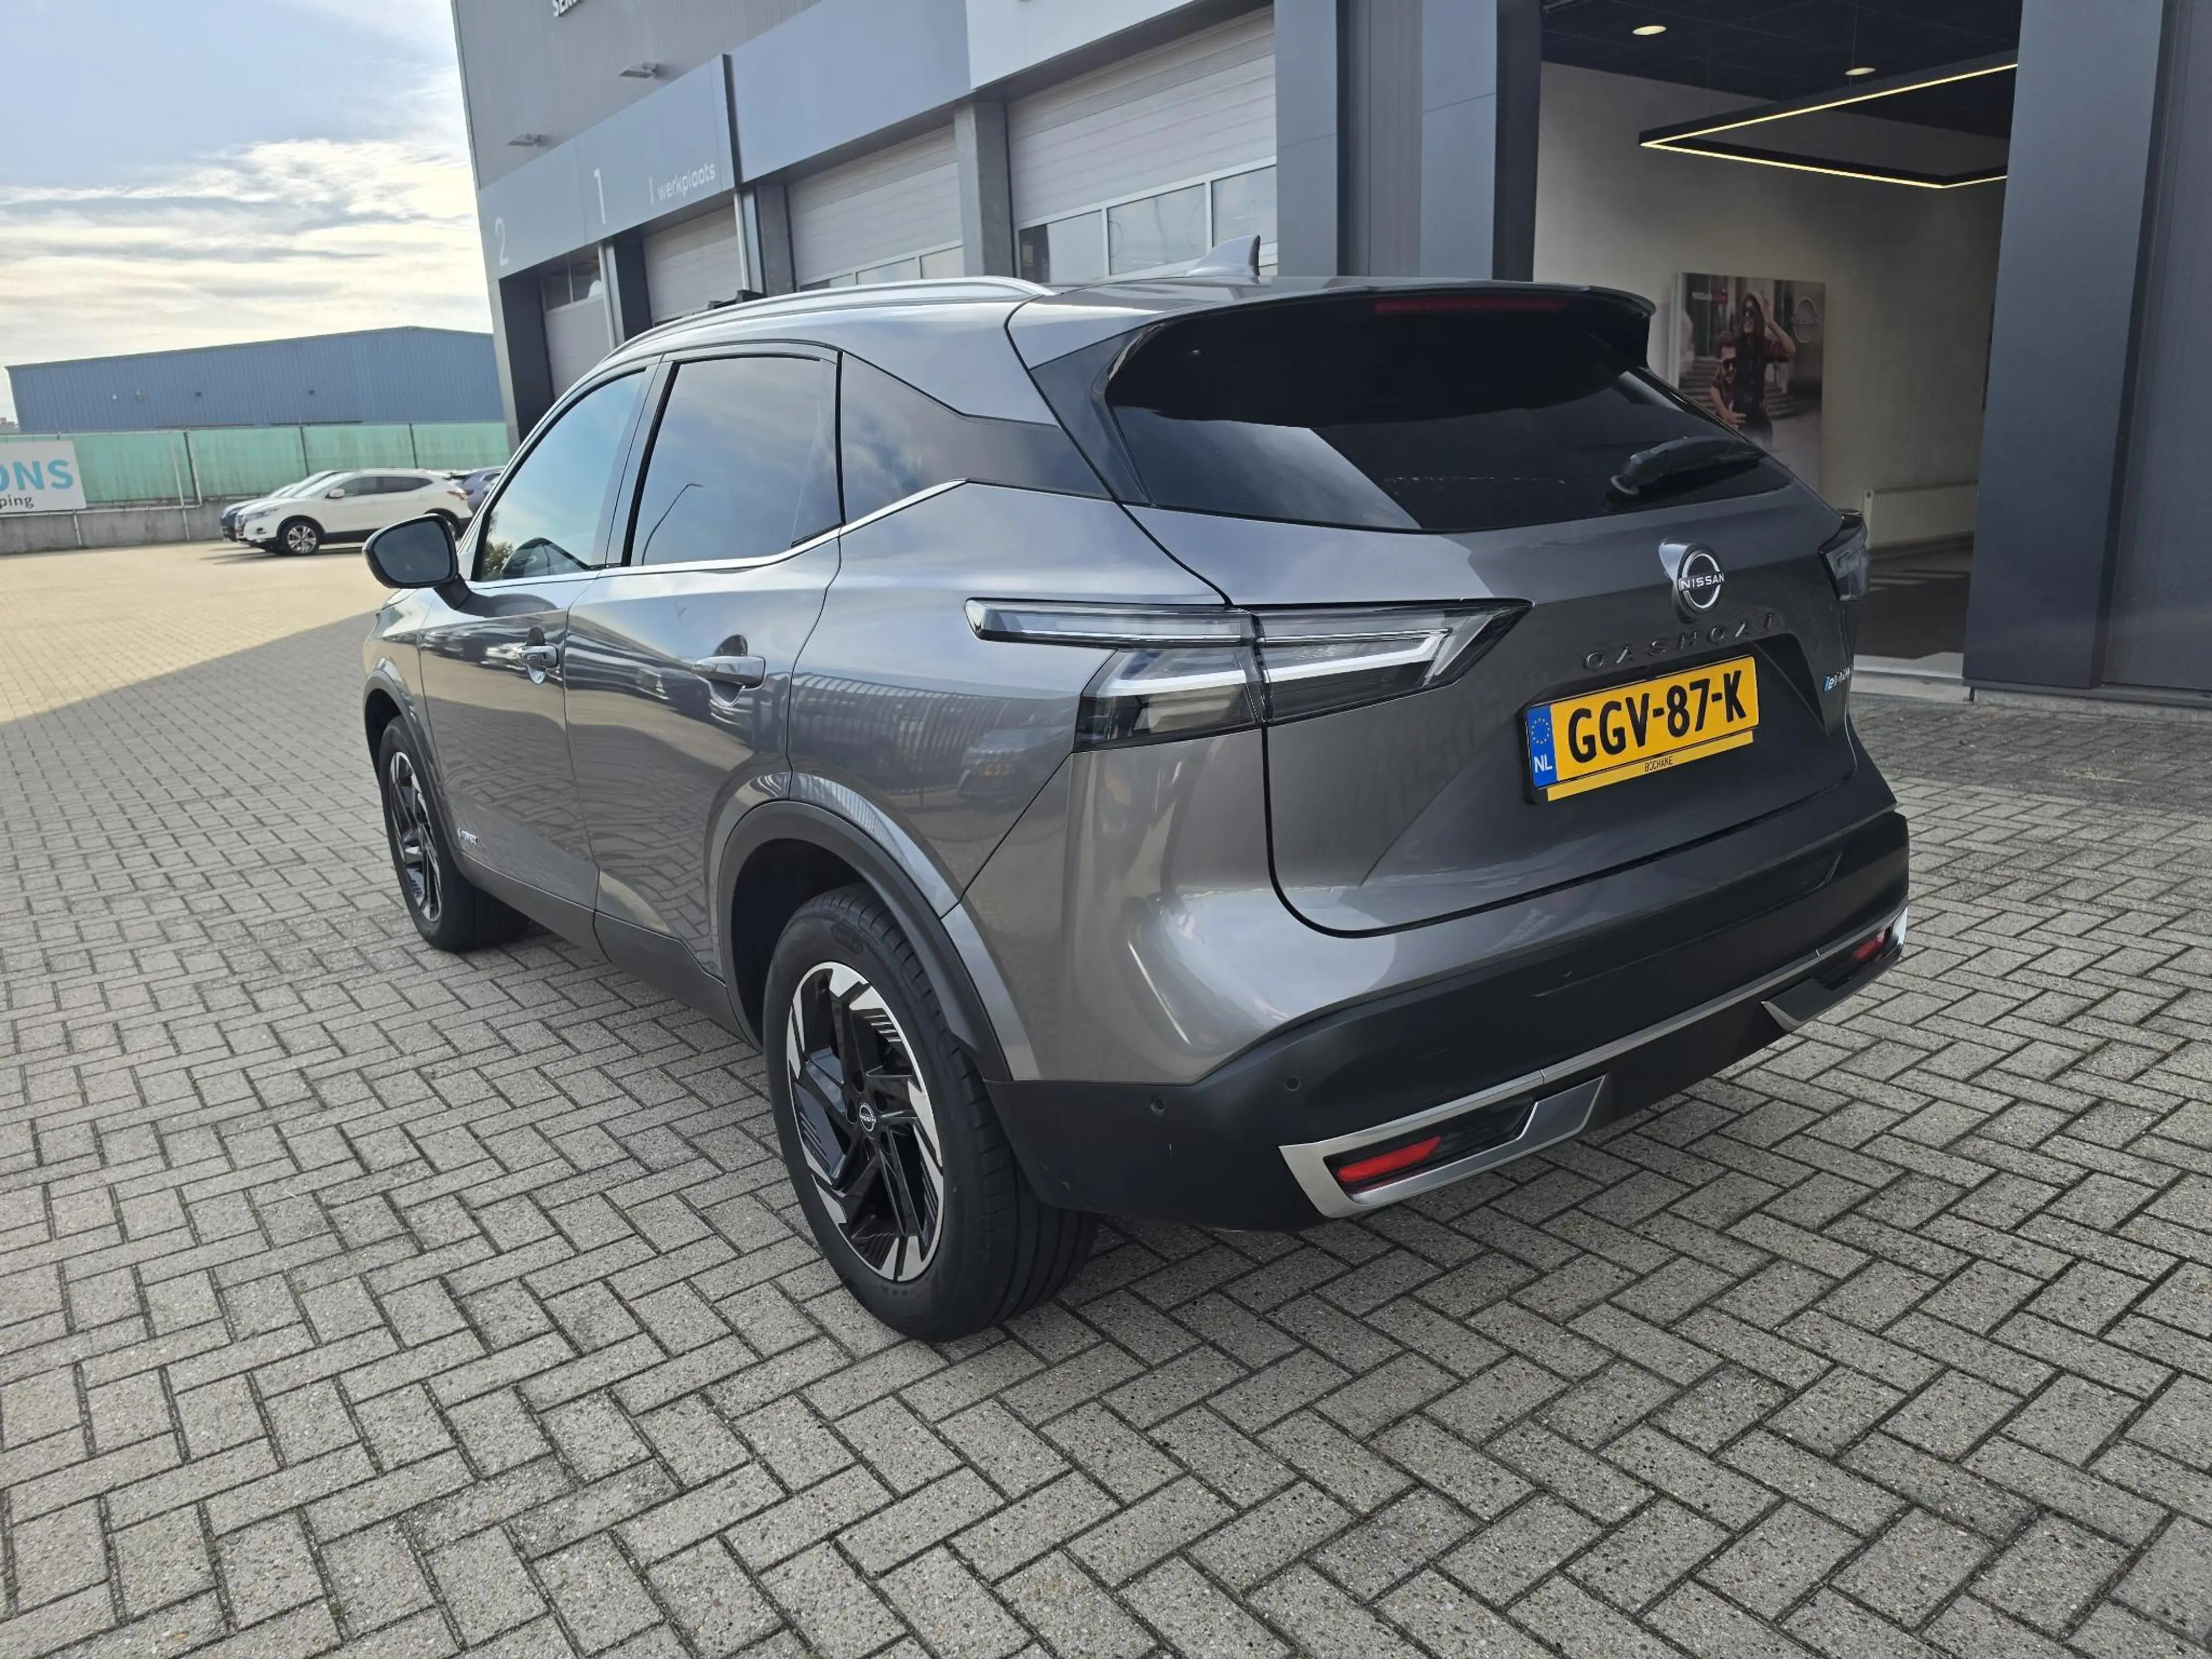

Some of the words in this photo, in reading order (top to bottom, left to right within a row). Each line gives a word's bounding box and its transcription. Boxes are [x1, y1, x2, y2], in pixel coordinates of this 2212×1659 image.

[593, 168, 605, 225] 1
[495, 217, 509, 267] 2
[1678, 573, 1725, 592] NISSAN
[1568, 670, 1747, 763] GGV-87-K
[1533, 753, 1553, 774] NL
